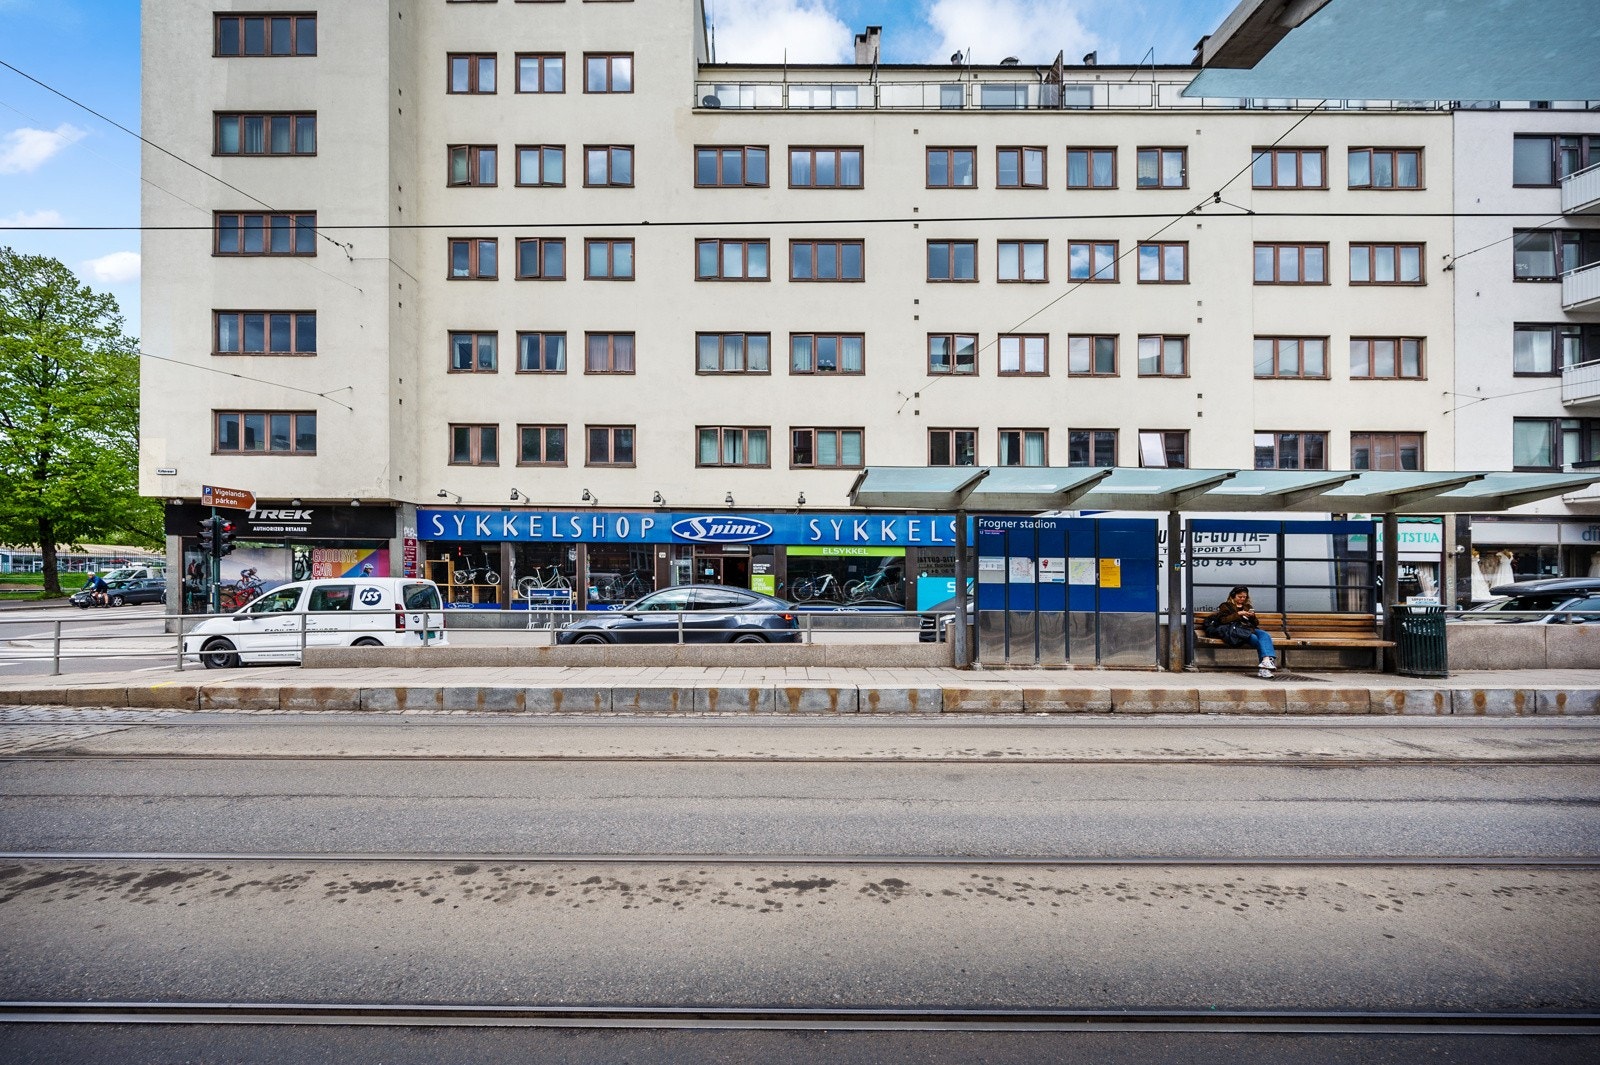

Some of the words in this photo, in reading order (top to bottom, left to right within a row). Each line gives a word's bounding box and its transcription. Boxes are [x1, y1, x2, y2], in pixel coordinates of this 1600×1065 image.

[215, 488, 247, 498] Vigelands-
[248, 509, 314, 519] TREK
[432, 514, 655, 538] SYKKELSHOP
[683, 518, 758, 538] Spinn
[978, 519, 1017, 530] Frogner
[1020, 519, 1057, 529] stadion
[313, 548, 358, 562] GOODBYE
[313, 562, 332, 577] CAR
[360, 589, 380, 602] ISS
